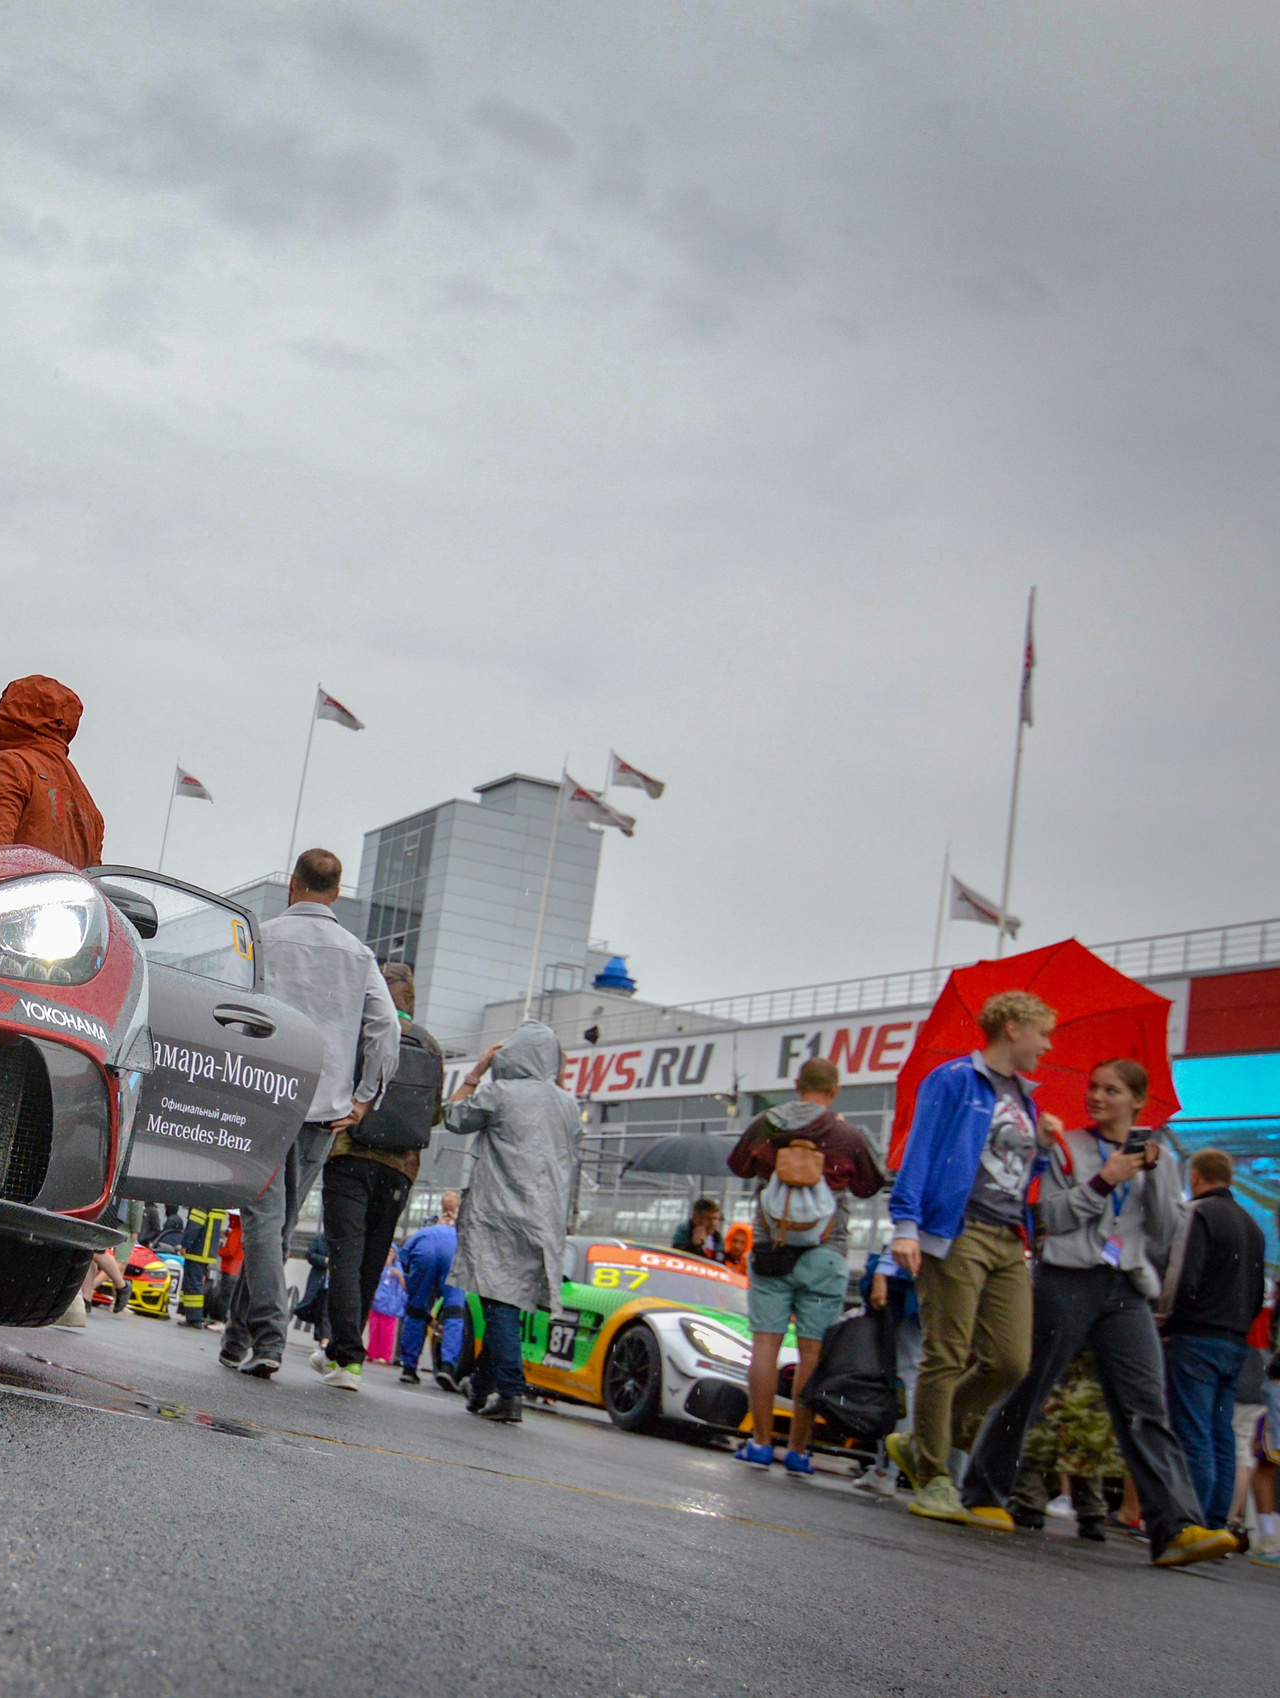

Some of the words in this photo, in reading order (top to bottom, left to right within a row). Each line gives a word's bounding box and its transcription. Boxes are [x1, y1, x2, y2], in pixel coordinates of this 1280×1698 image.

[20, 998, 110, 1045] YOKOHAMA
[777, 1020, 928, 1078] F1NE
[153, 1041, 299, 1105] амара-Моторс
[161, 1096, 220, 1120] Официальный
[220, 1112, 247, 1128] дилер
[146, 1113, 252, 1153] Mercedes-Benz
[592, 1267, 650, 1290] 87
[549, 1325, 575, 1354] 87
